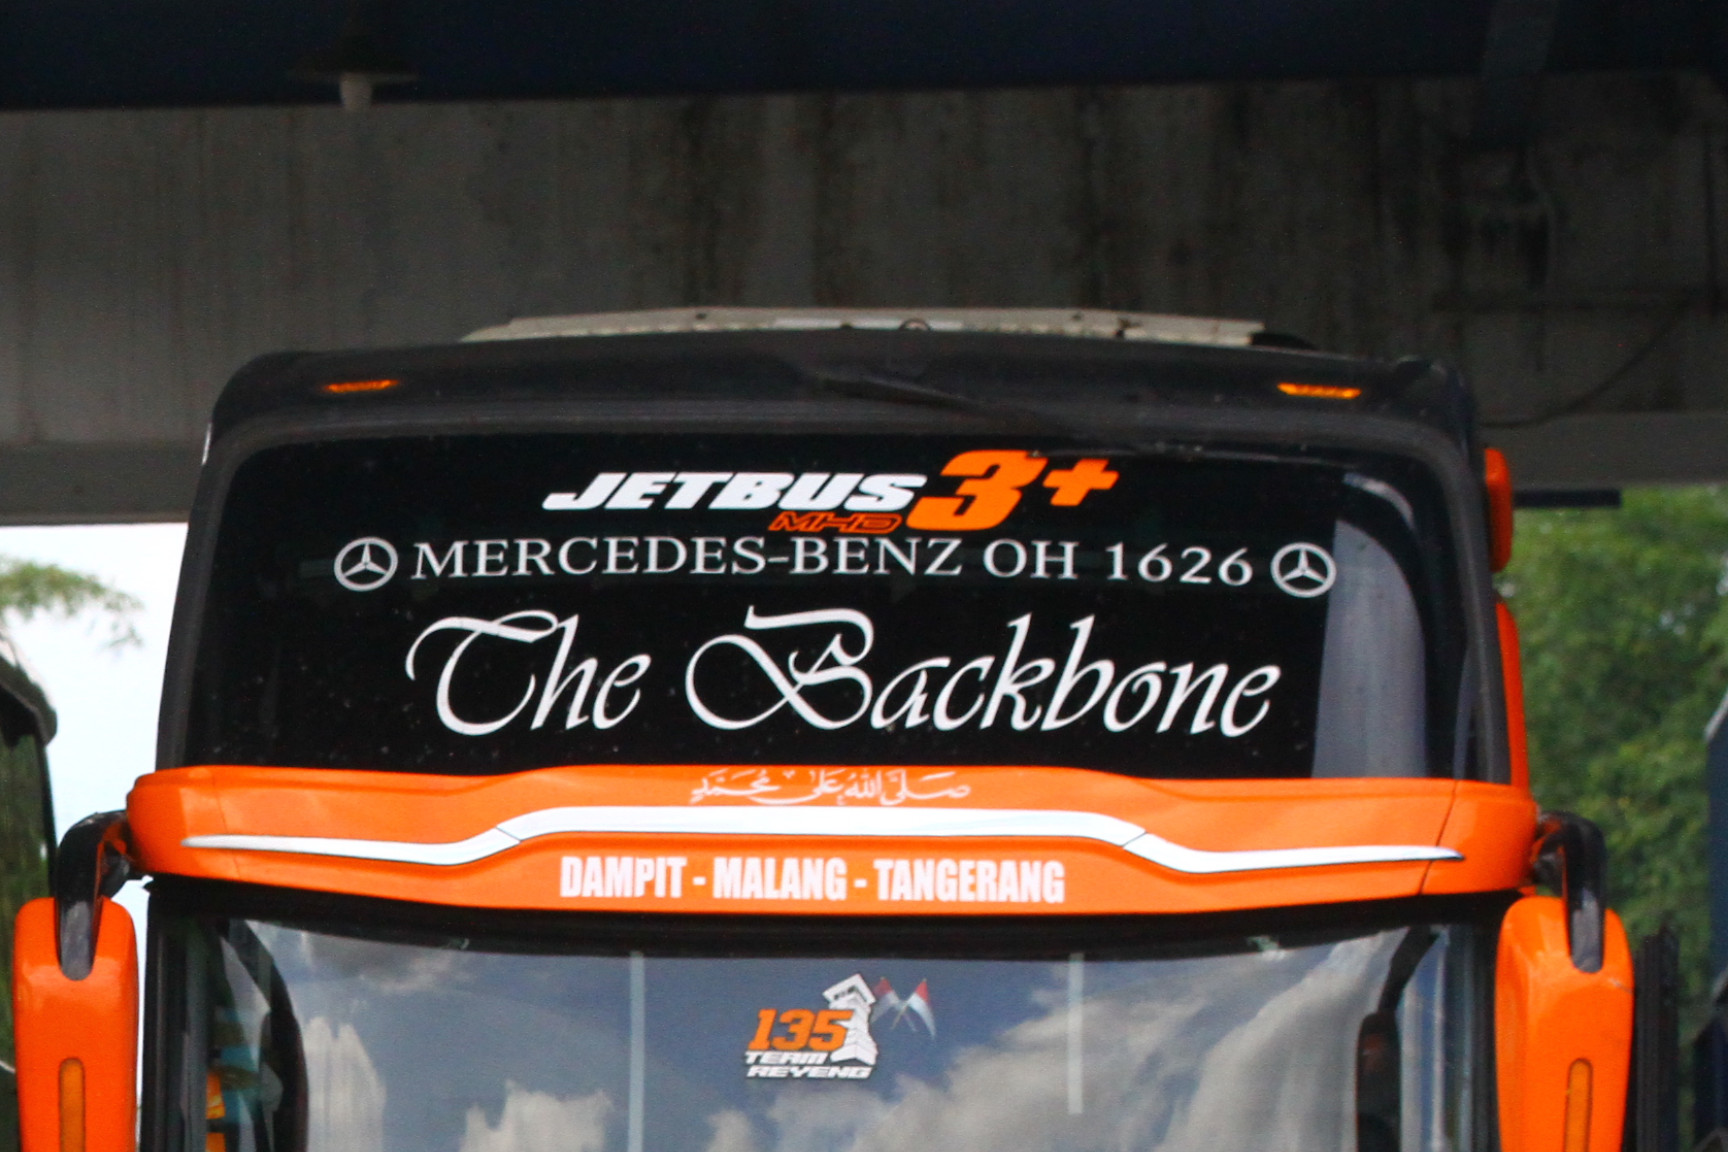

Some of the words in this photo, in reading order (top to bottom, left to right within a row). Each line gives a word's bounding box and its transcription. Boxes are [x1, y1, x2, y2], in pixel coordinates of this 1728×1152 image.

[542, 471, 928, 512] JETBUS
[768, 511, 904, 535] MHD
[411, 536, 963, 580] MERCEDES-BENZ
[983, 538, 1079, 579] OH
[1106, 542, 1254, 586] 1626
[405, 610, 652, 737] The
[685, 604, 1282, 737] Backbone
[560, 856, 687, 899] DAMPIT
[713, 857, 847, 900] MALANG
[874, 858, 1066, 904] TANGERANG
[747, 1008, 854, 1051] 135
[745, 1051, 829, 1065] TEAM
